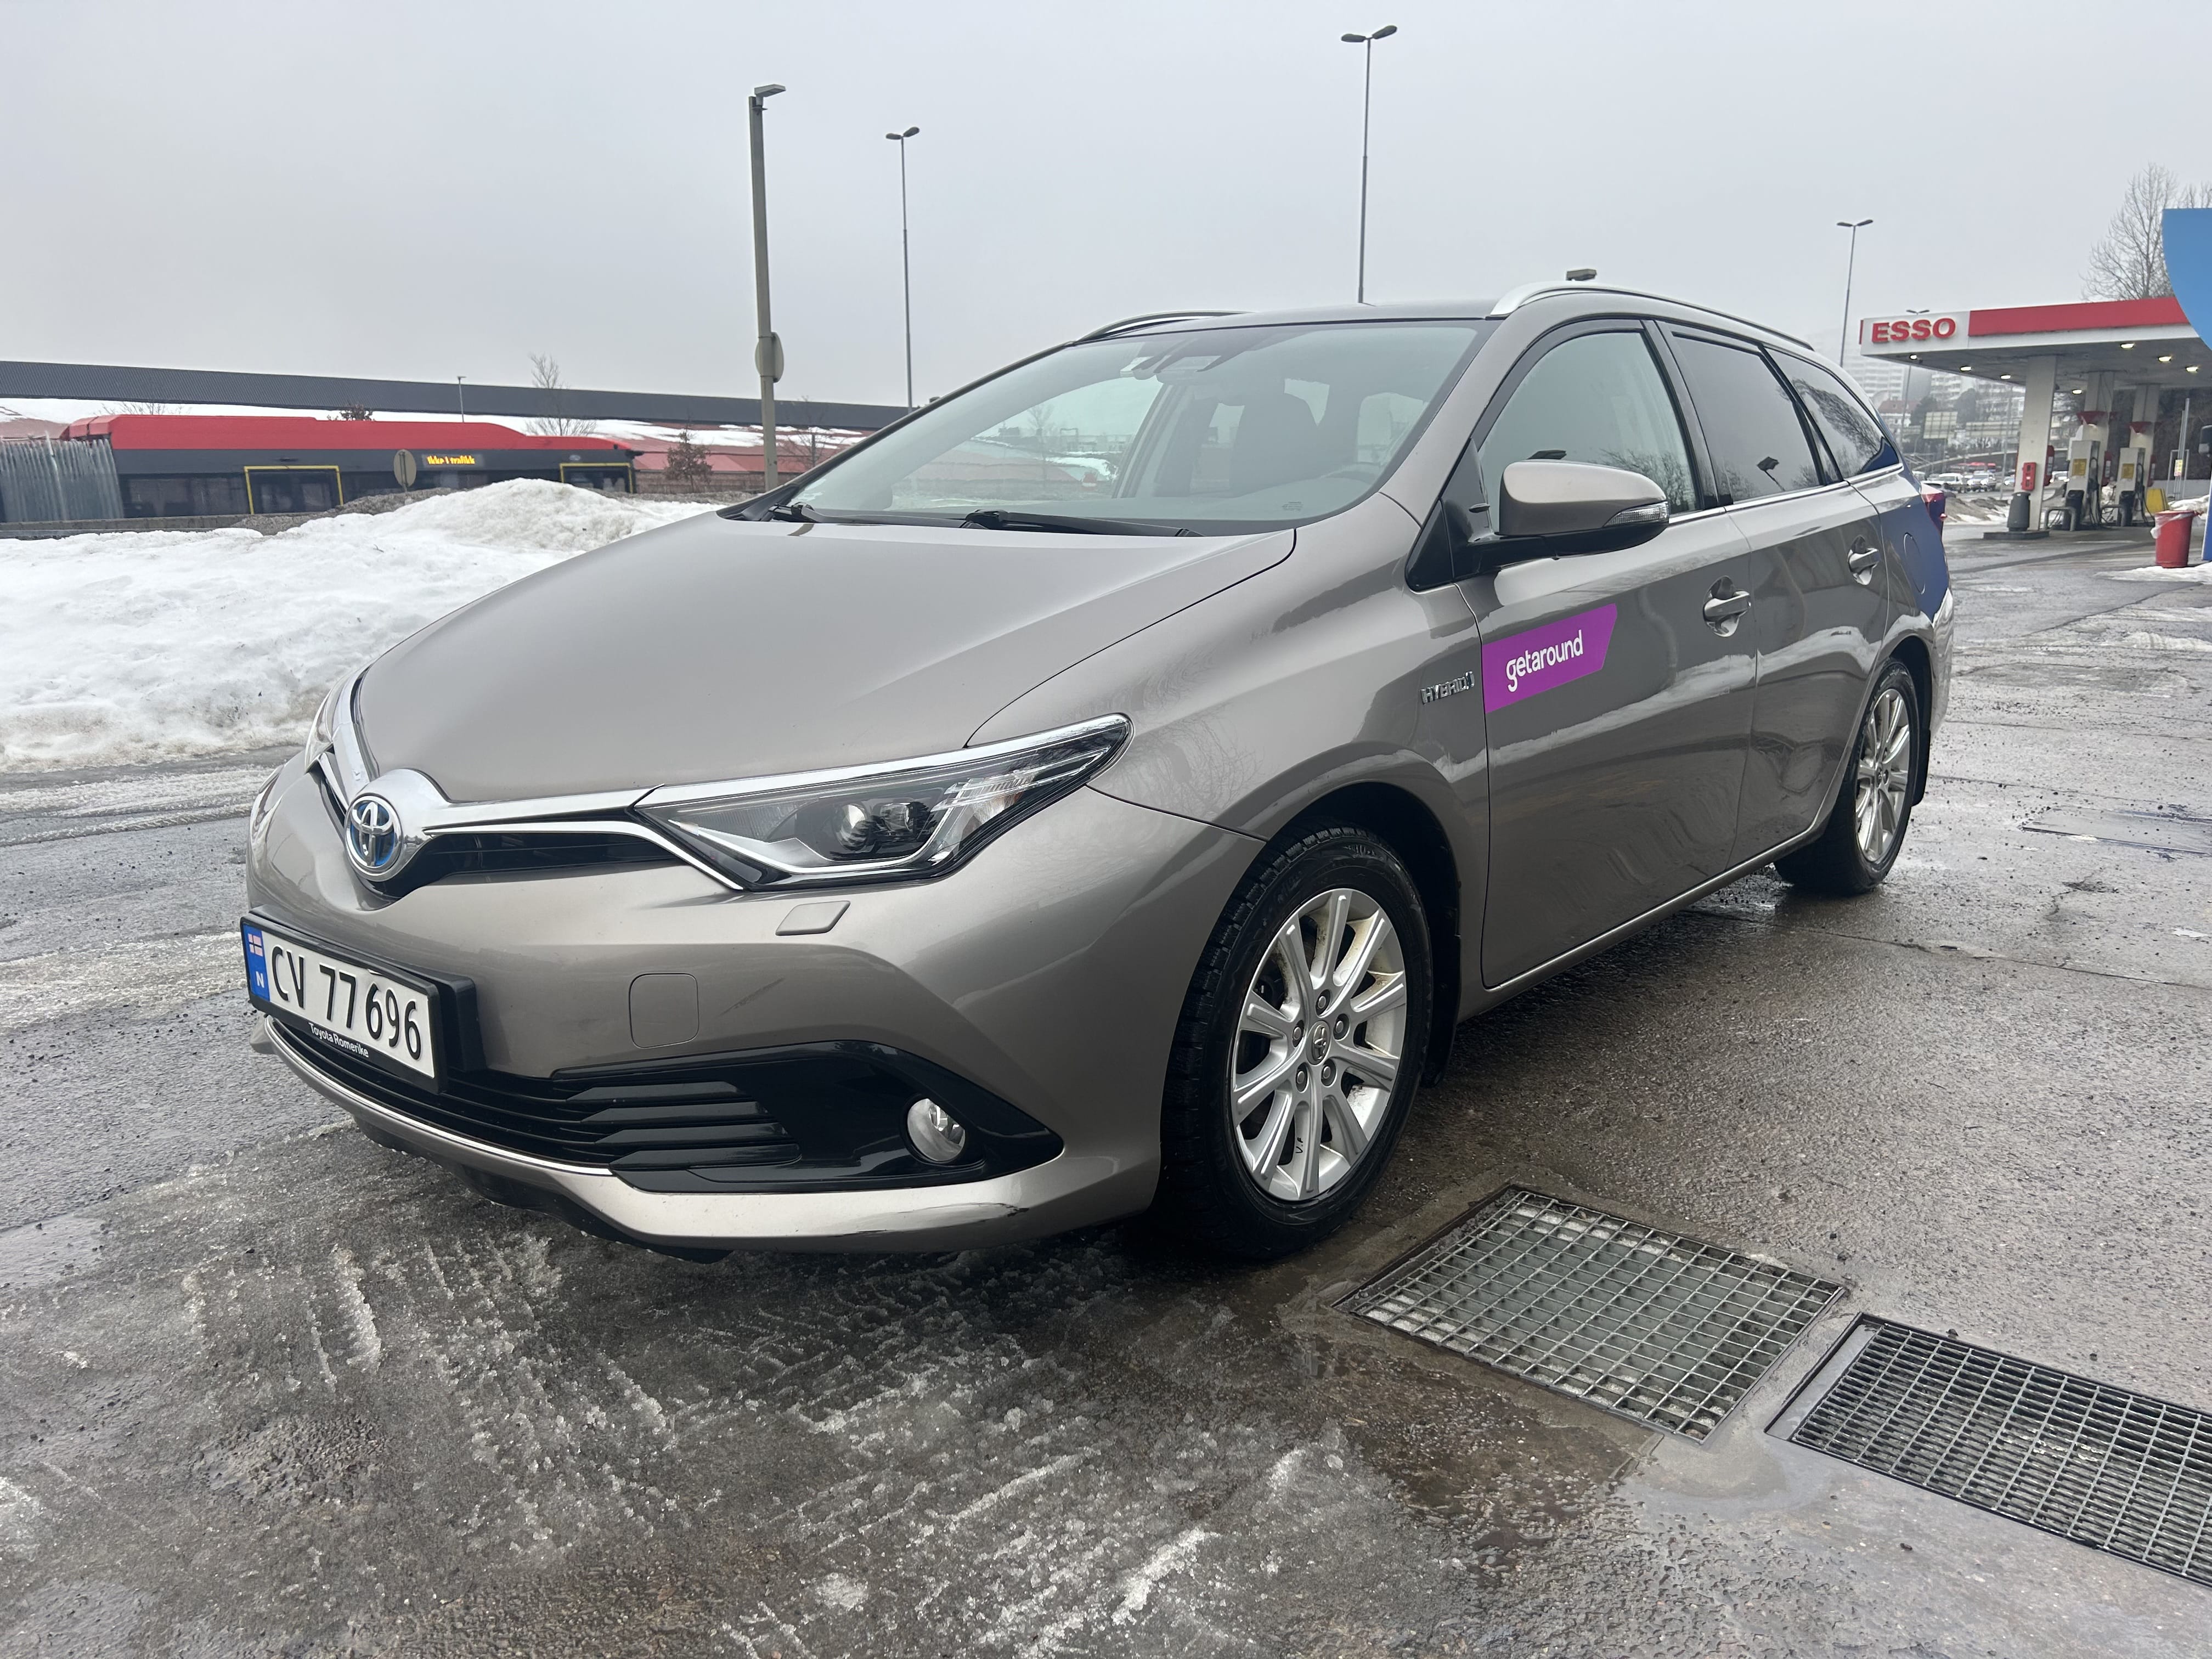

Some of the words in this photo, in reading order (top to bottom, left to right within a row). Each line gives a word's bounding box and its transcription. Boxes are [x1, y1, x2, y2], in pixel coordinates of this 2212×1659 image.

[1872, 318, 1956, 343] ESSO
[1506, 629, 1583, 692] getaround
[1421, 676, 1468, 703] HYBRID
[255, 970, 265, 988] N
[272, 945, 304, 1009] CV
[319, 962, 421, 1060] 77696
[308, 1022, 334, 1042] Toyota
[332, 1033, 369, 1058] Romerike
